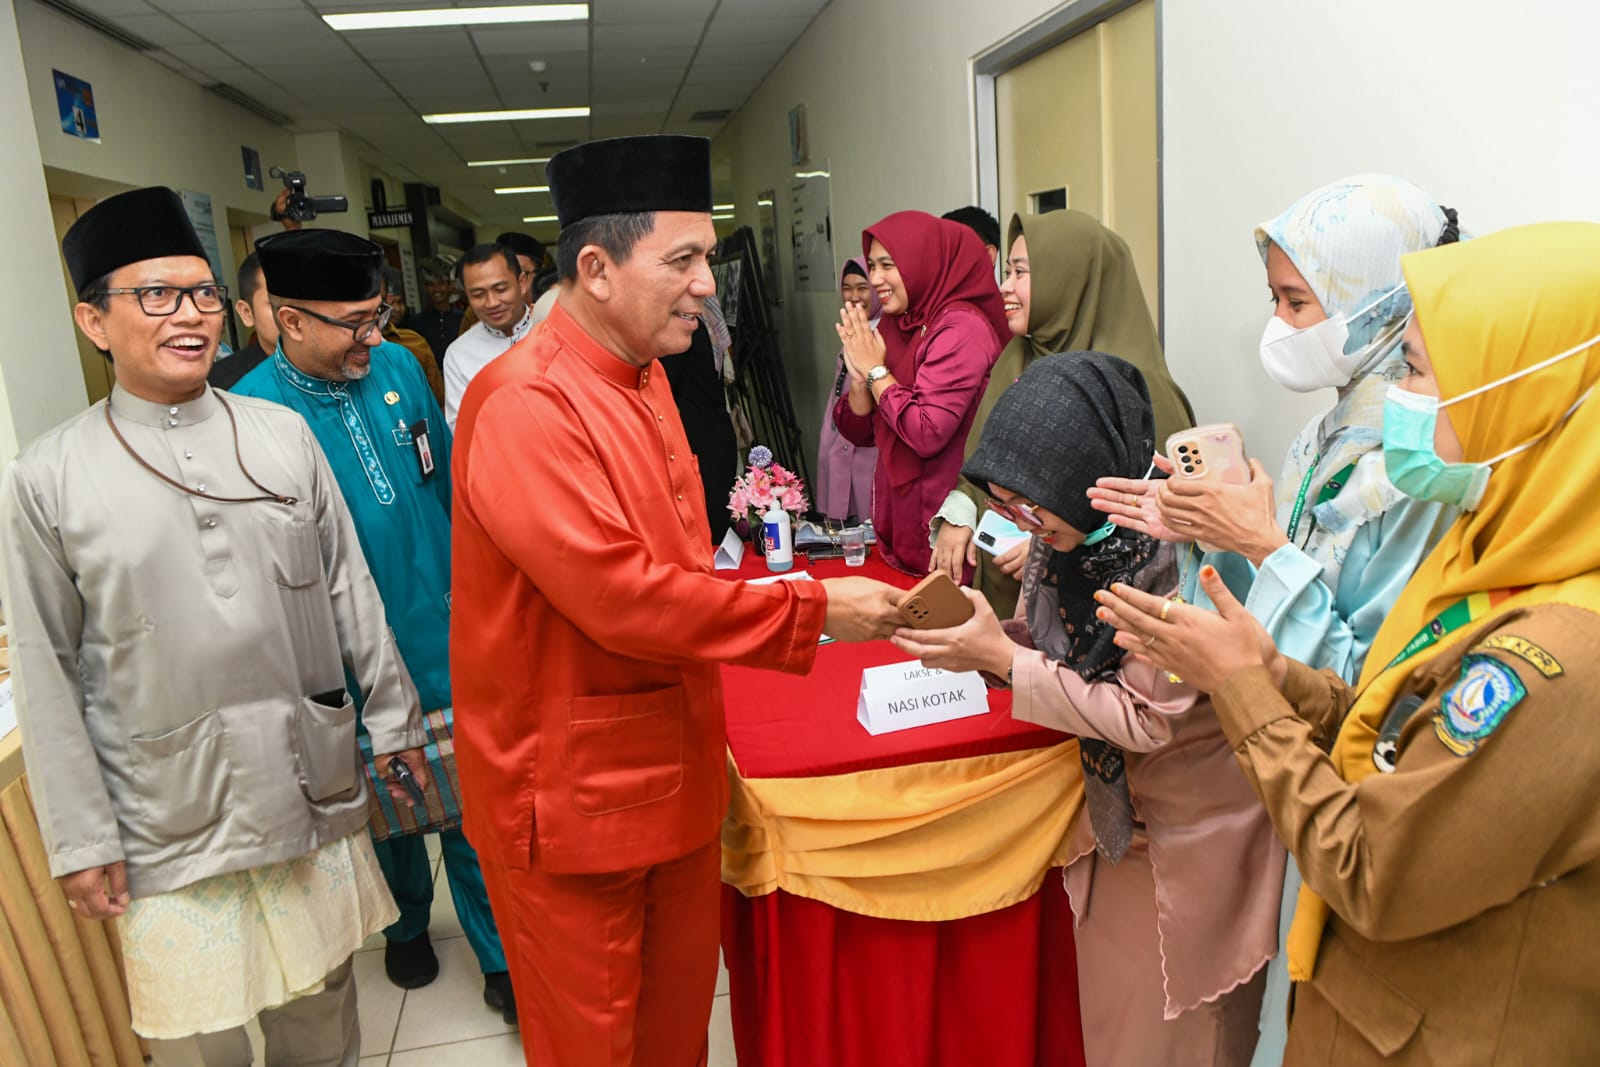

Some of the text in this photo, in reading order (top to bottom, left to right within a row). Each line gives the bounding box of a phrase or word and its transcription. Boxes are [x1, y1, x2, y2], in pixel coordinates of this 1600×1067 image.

[371, 212, 414, 227] MANAJEMEN
[904, 668, 932, 681] LAKSE
[888, 689, 966, 715] NASI KOTAK
